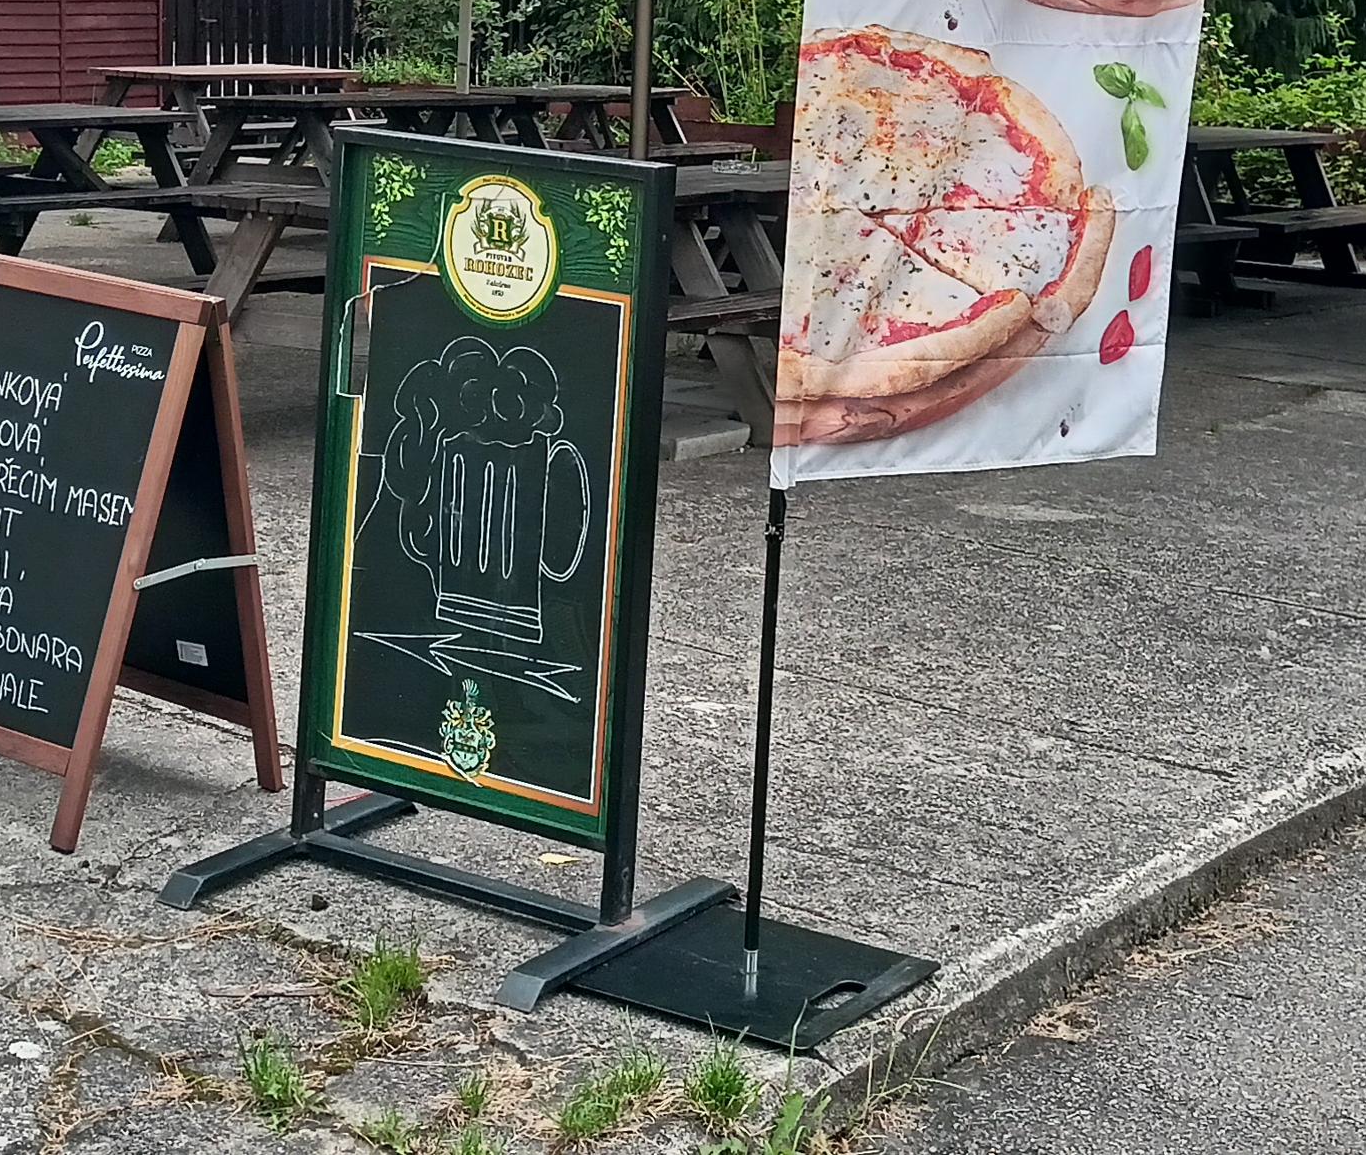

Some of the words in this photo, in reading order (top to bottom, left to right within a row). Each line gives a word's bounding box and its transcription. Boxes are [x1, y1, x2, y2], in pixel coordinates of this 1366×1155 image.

[491, 219, 509, 242] R
[463, 257, 534, 282] ROHOZEC
[75, 320, 166, 383] Perfettissima
[131, 344, 153, 357] PIZZA
